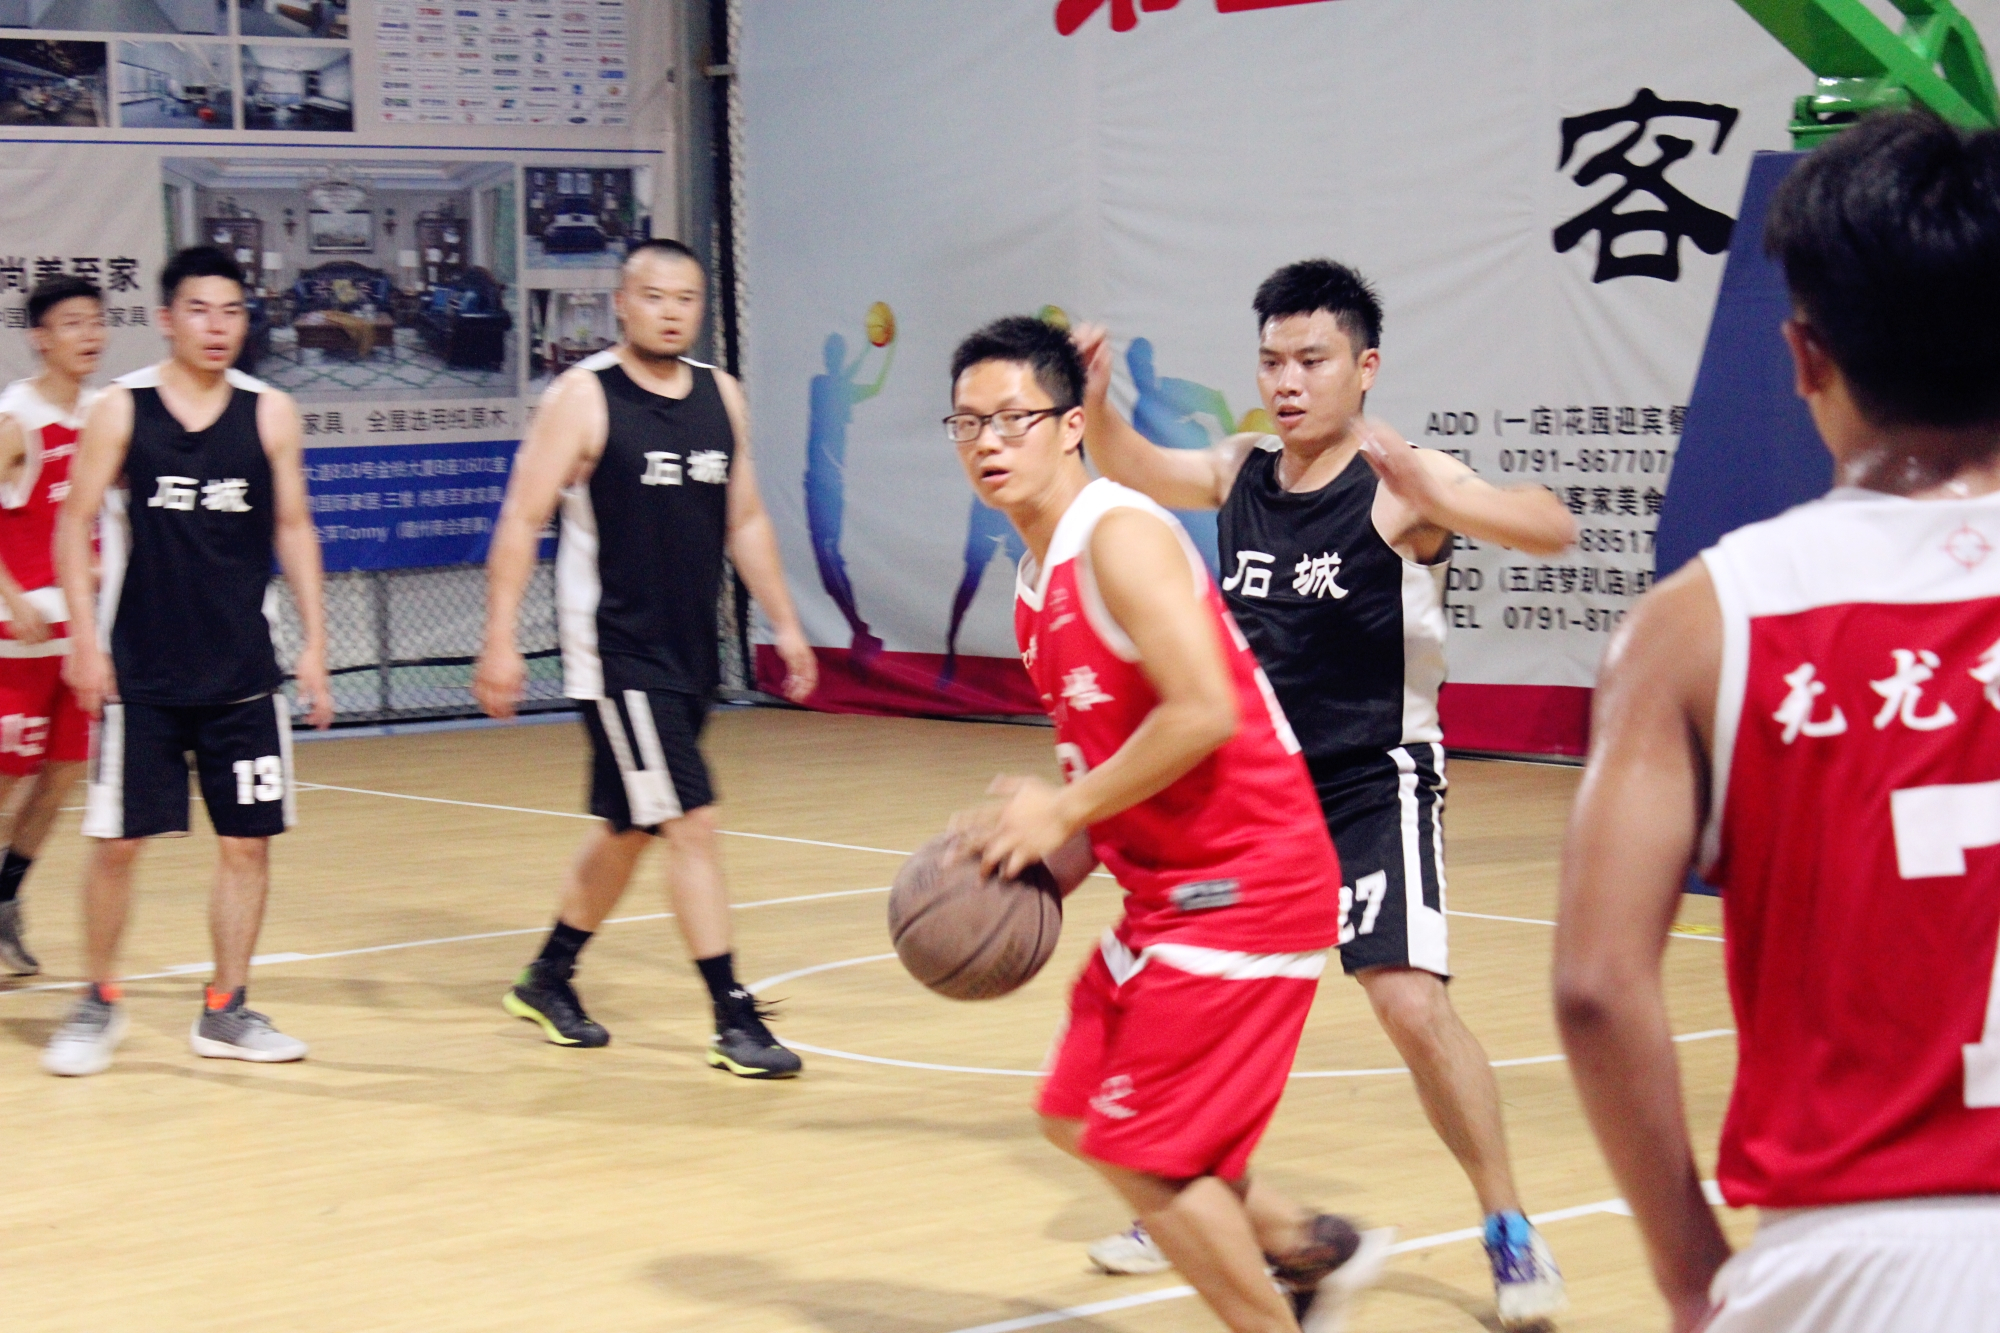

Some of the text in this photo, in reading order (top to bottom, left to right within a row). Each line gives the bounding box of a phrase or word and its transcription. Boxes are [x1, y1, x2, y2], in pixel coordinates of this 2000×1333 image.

[1554, 87, 1740, 284] 客
[1425, 411, 1479, 436] ADD
[147, 476, 252, 512] 石城
[1222, 550, 1349, 599] 石城
[1447, 567, 1483, 591] DD
[232, 755, 284, 804] 13
